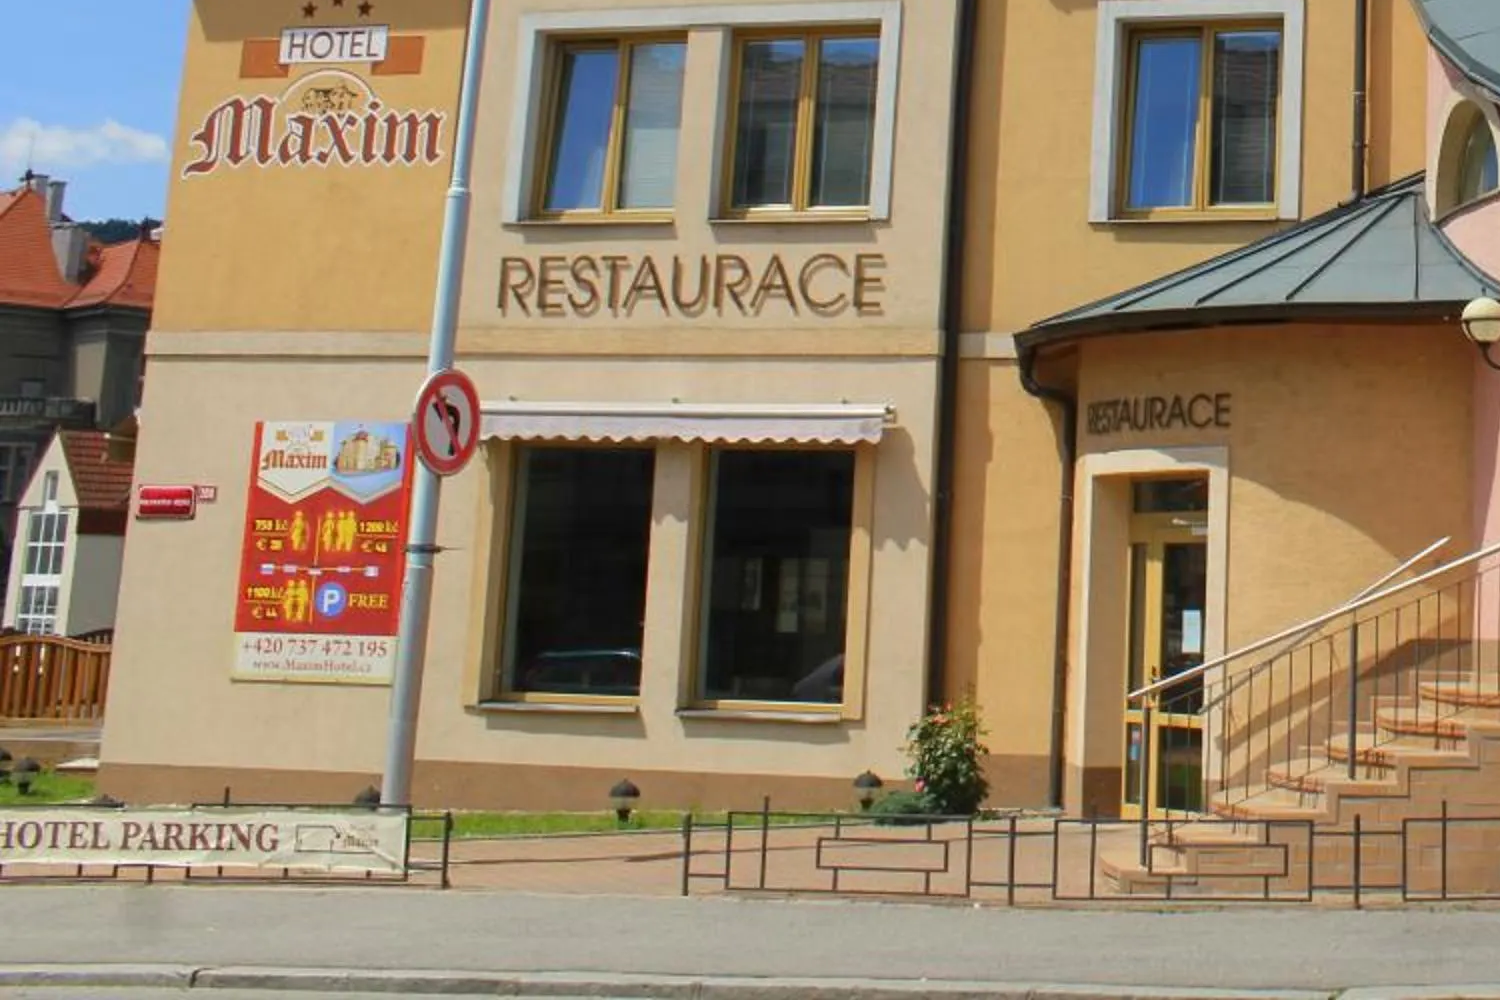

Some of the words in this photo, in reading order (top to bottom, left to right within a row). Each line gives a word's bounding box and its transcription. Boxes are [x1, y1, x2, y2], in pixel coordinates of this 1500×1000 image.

[287, 31, 379, 59] HOTEL
[182, 95, 445, 178] Maxim
[497, 253, 887, 317] RESTAURACE
[1086, 393, 1232, 434] RESTAURACE
[261, 449, 327, 470] Maxim
[349, 592, 389, 609] FREE
[243, 637, 283, 655] +420
[287, 638, 318, 656] 737
[322, 639, 353, 657] 472
[358, 640, 388, 657] 195
[0, 821, 110, 850] HOTEL
[119, 821, 280, 853] PARKING
